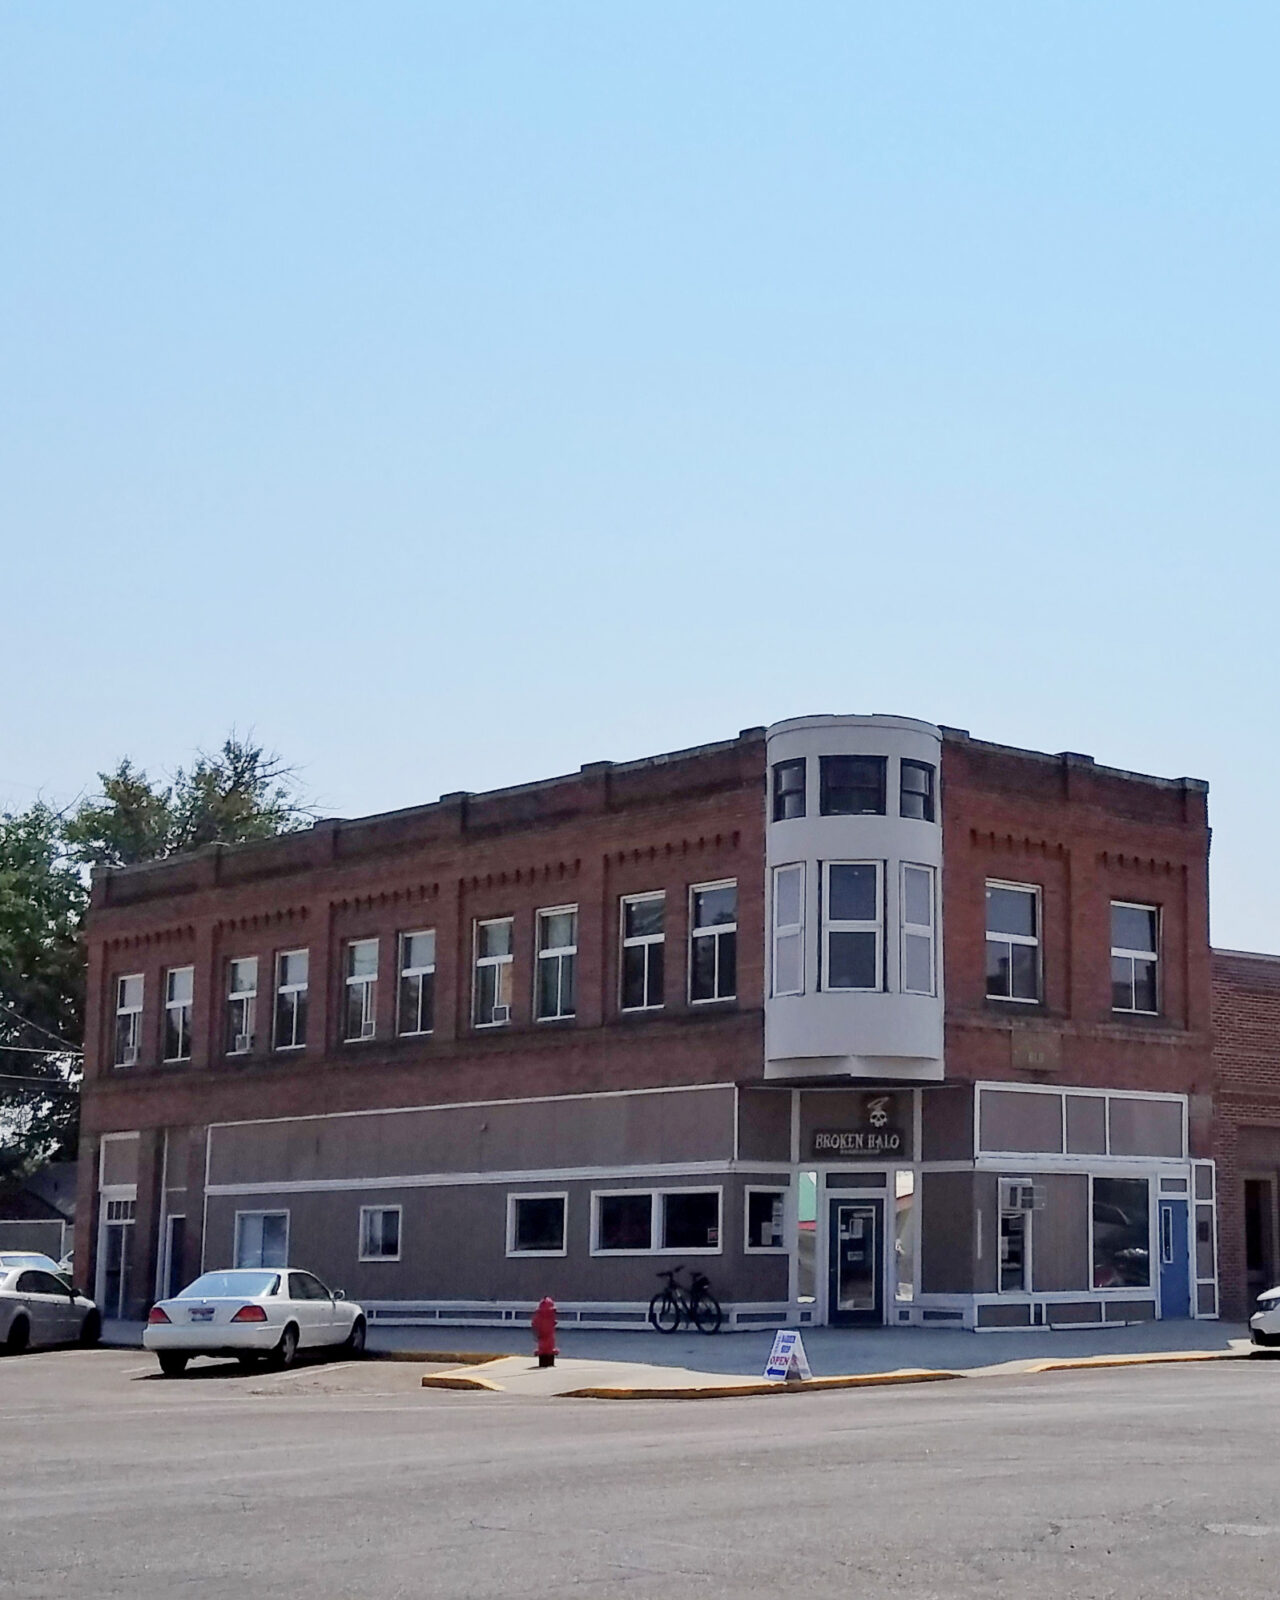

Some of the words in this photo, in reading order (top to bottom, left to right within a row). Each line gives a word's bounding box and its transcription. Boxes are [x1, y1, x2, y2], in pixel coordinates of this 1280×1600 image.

[815, 1134, 863, 1148] BROKEN
[868, 1134, 900, 1148] HALO
[770, 1356, 790, 1366] OPEN
